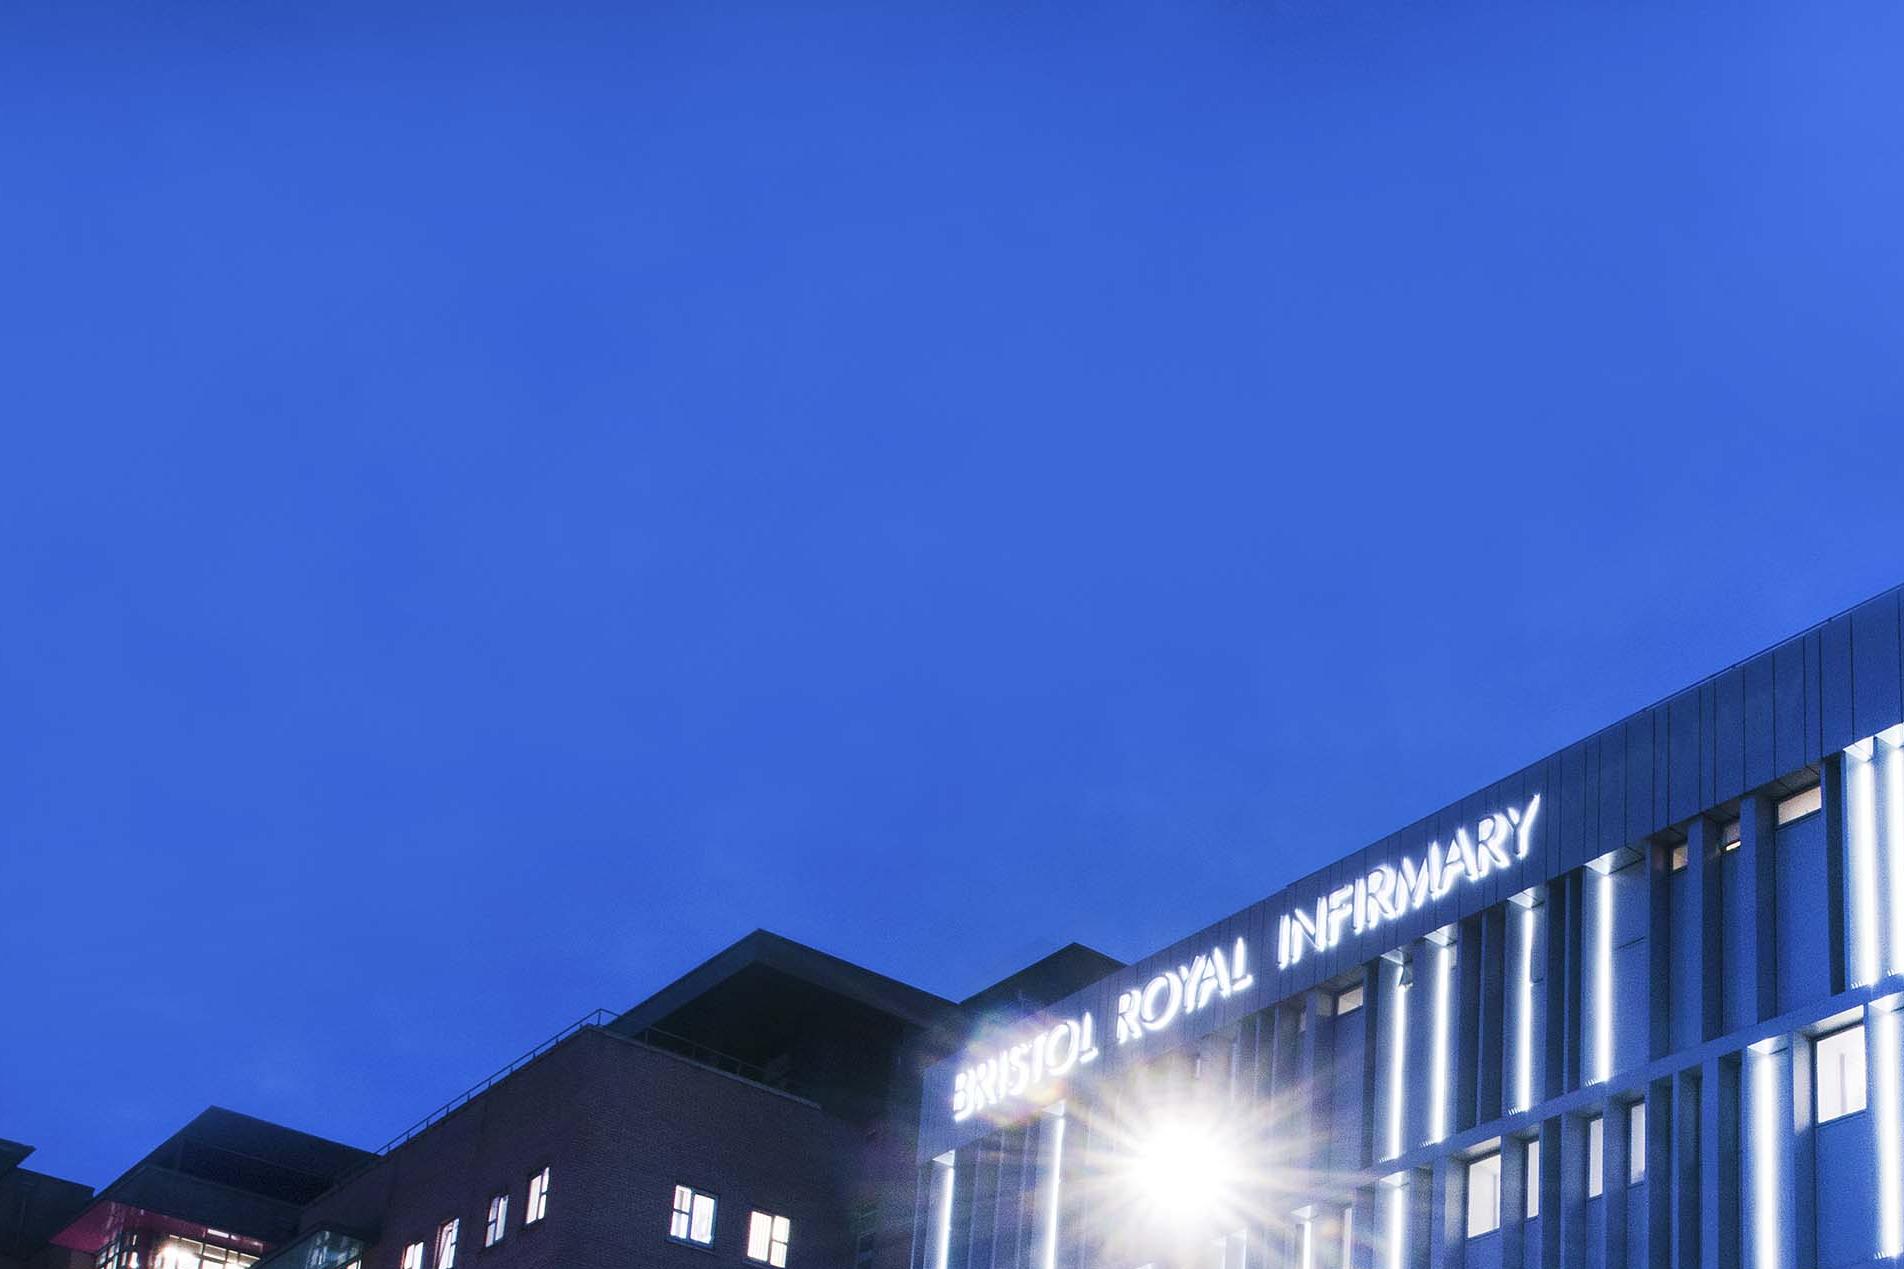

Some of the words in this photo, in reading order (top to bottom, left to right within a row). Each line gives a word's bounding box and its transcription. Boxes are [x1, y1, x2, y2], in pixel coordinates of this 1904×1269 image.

[953, 1011, 1099, 1122] BRISTOL
[1116, 936, 1254, 1044] ROYAL
[1277, 793, 1541, 970] INFIRMARY
